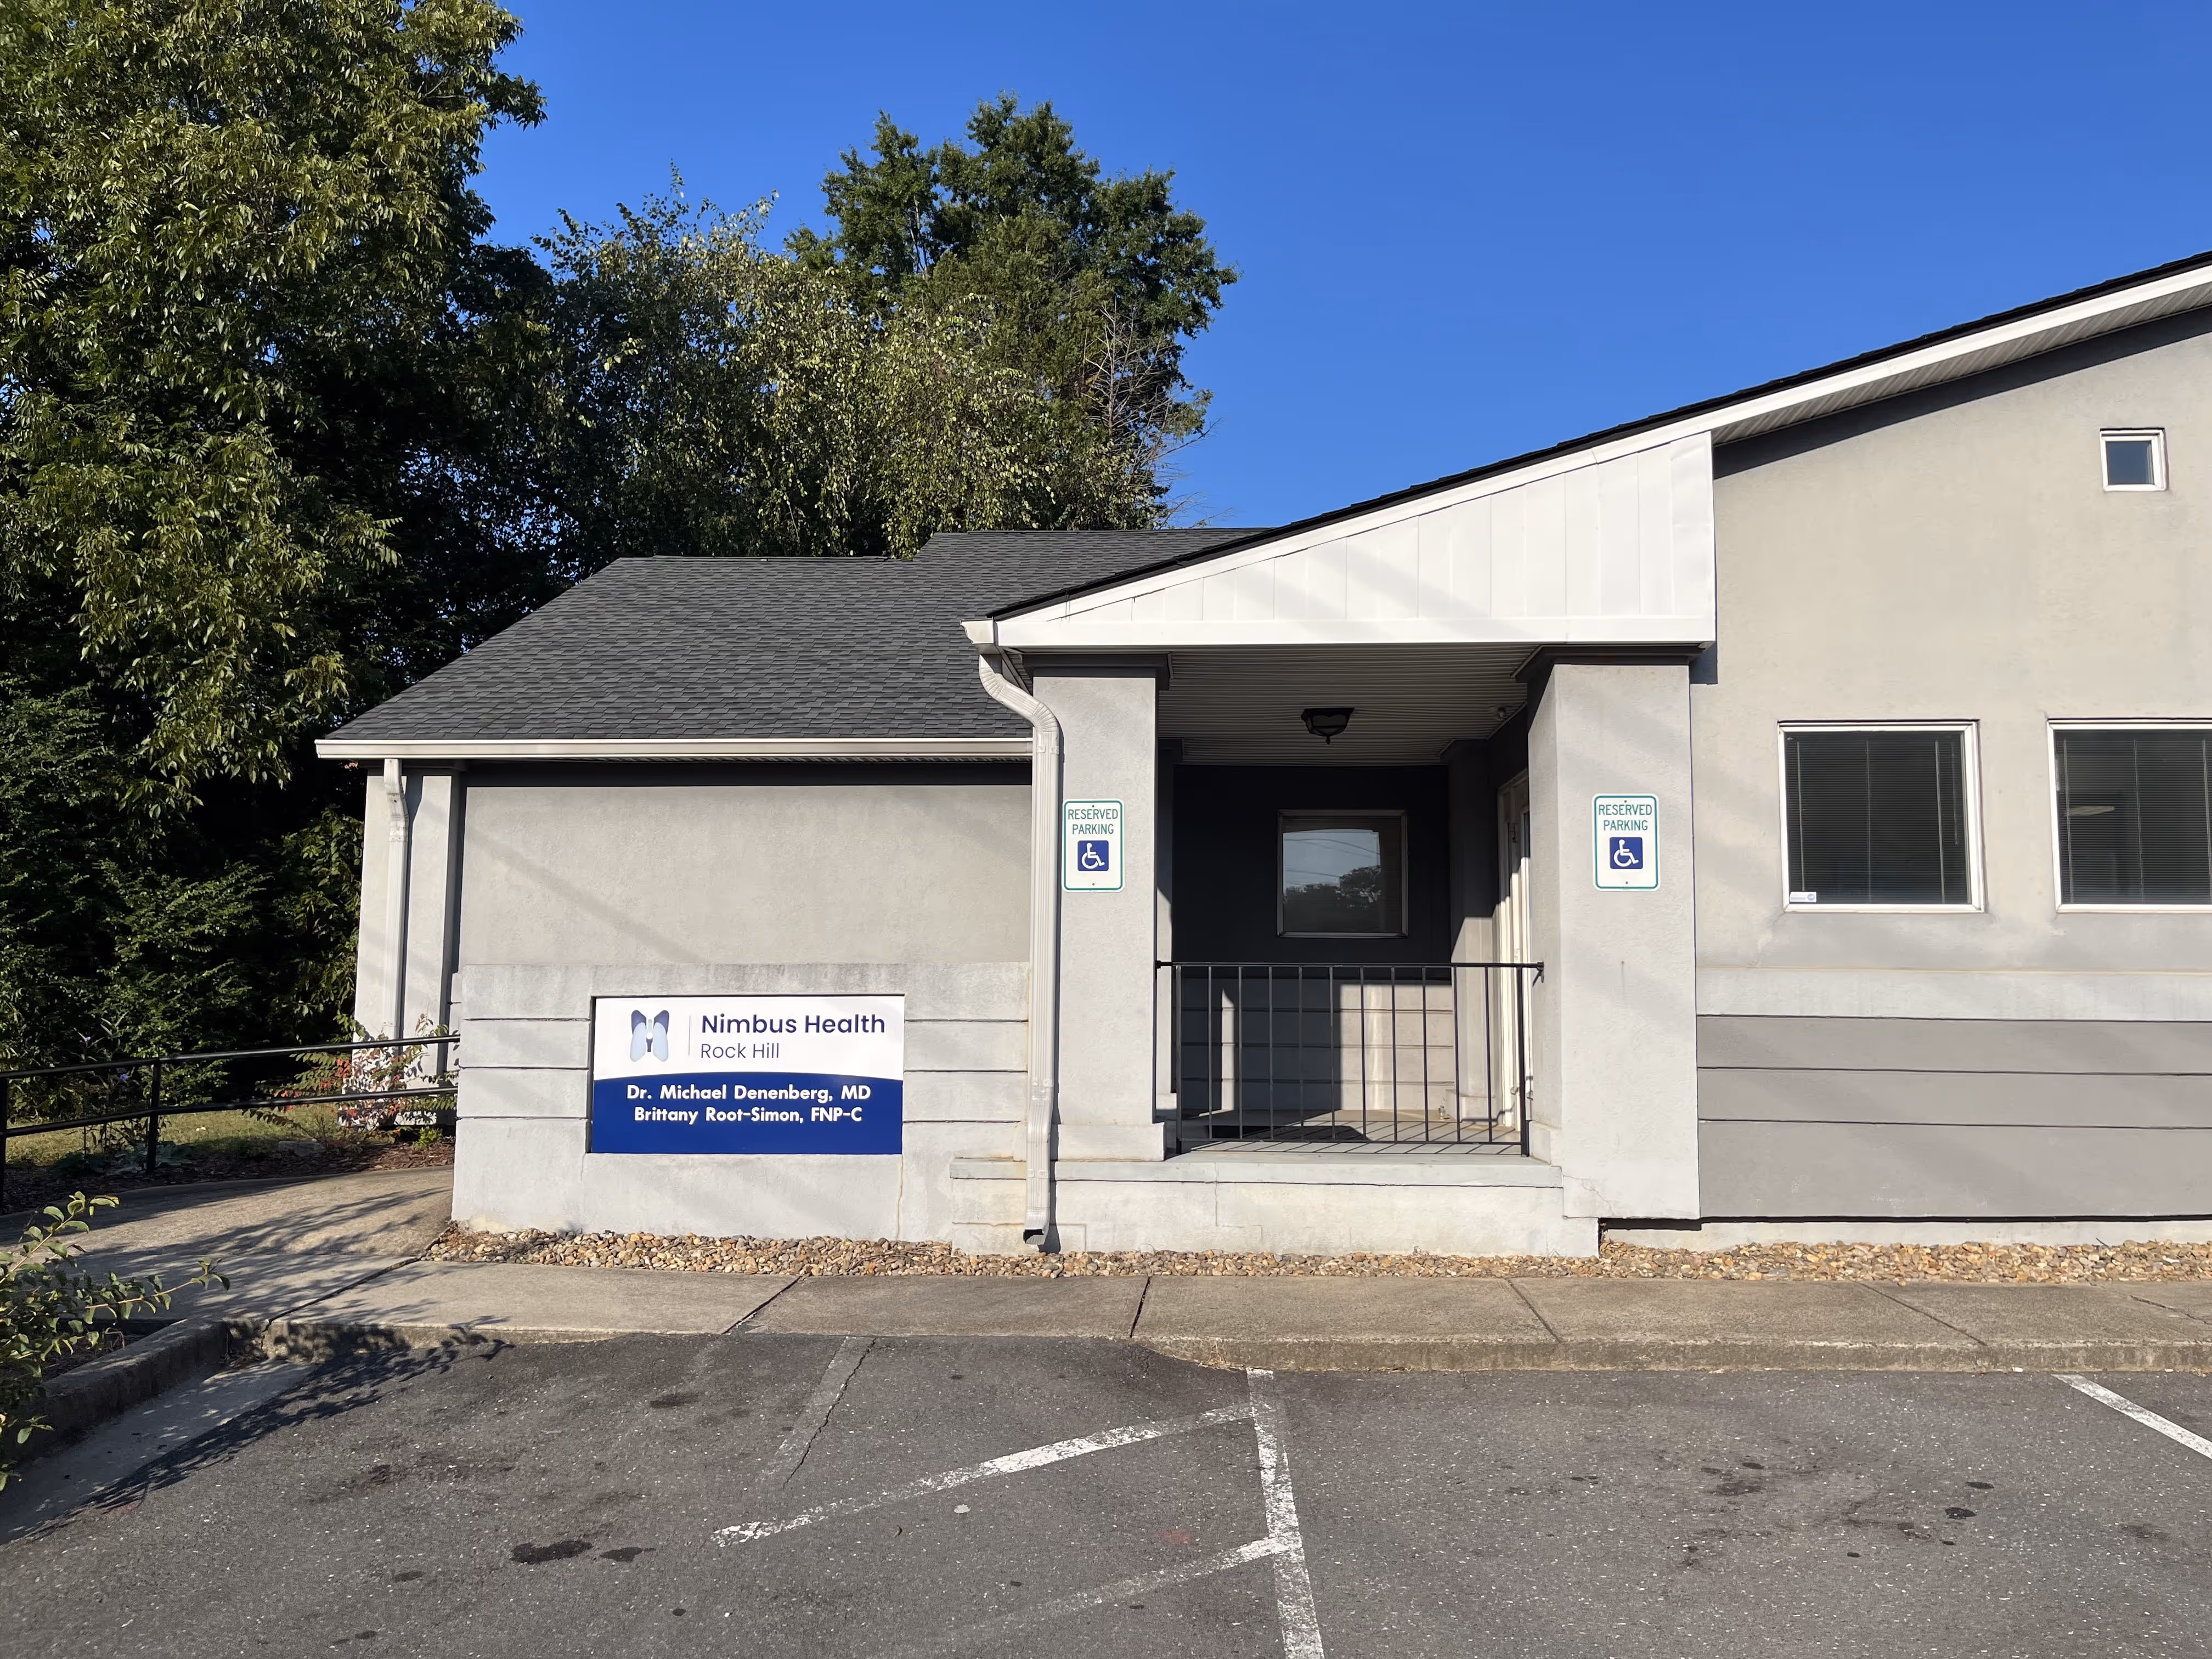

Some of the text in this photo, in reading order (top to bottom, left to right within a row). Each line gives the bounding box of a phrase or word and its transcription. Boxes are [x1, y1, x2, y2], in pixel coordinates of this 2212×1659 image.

[1068, 809, 1119, 820] RESERVED
[1598, 804, 1652, 816] RESERVED
[1072, 823, 1114, 834] PARKING
[1603, 819, 1649, 831] PARKING
[701, 1013, 885, 1034] Nimbus Health
[700, 1042, 780, 1058] Rock Hill
[627, 1084, 871, 1104] Dr. Michael Denenberg, MD
[634, 1107, 862, 1125] Brittany Root-Simon, FNP-C
